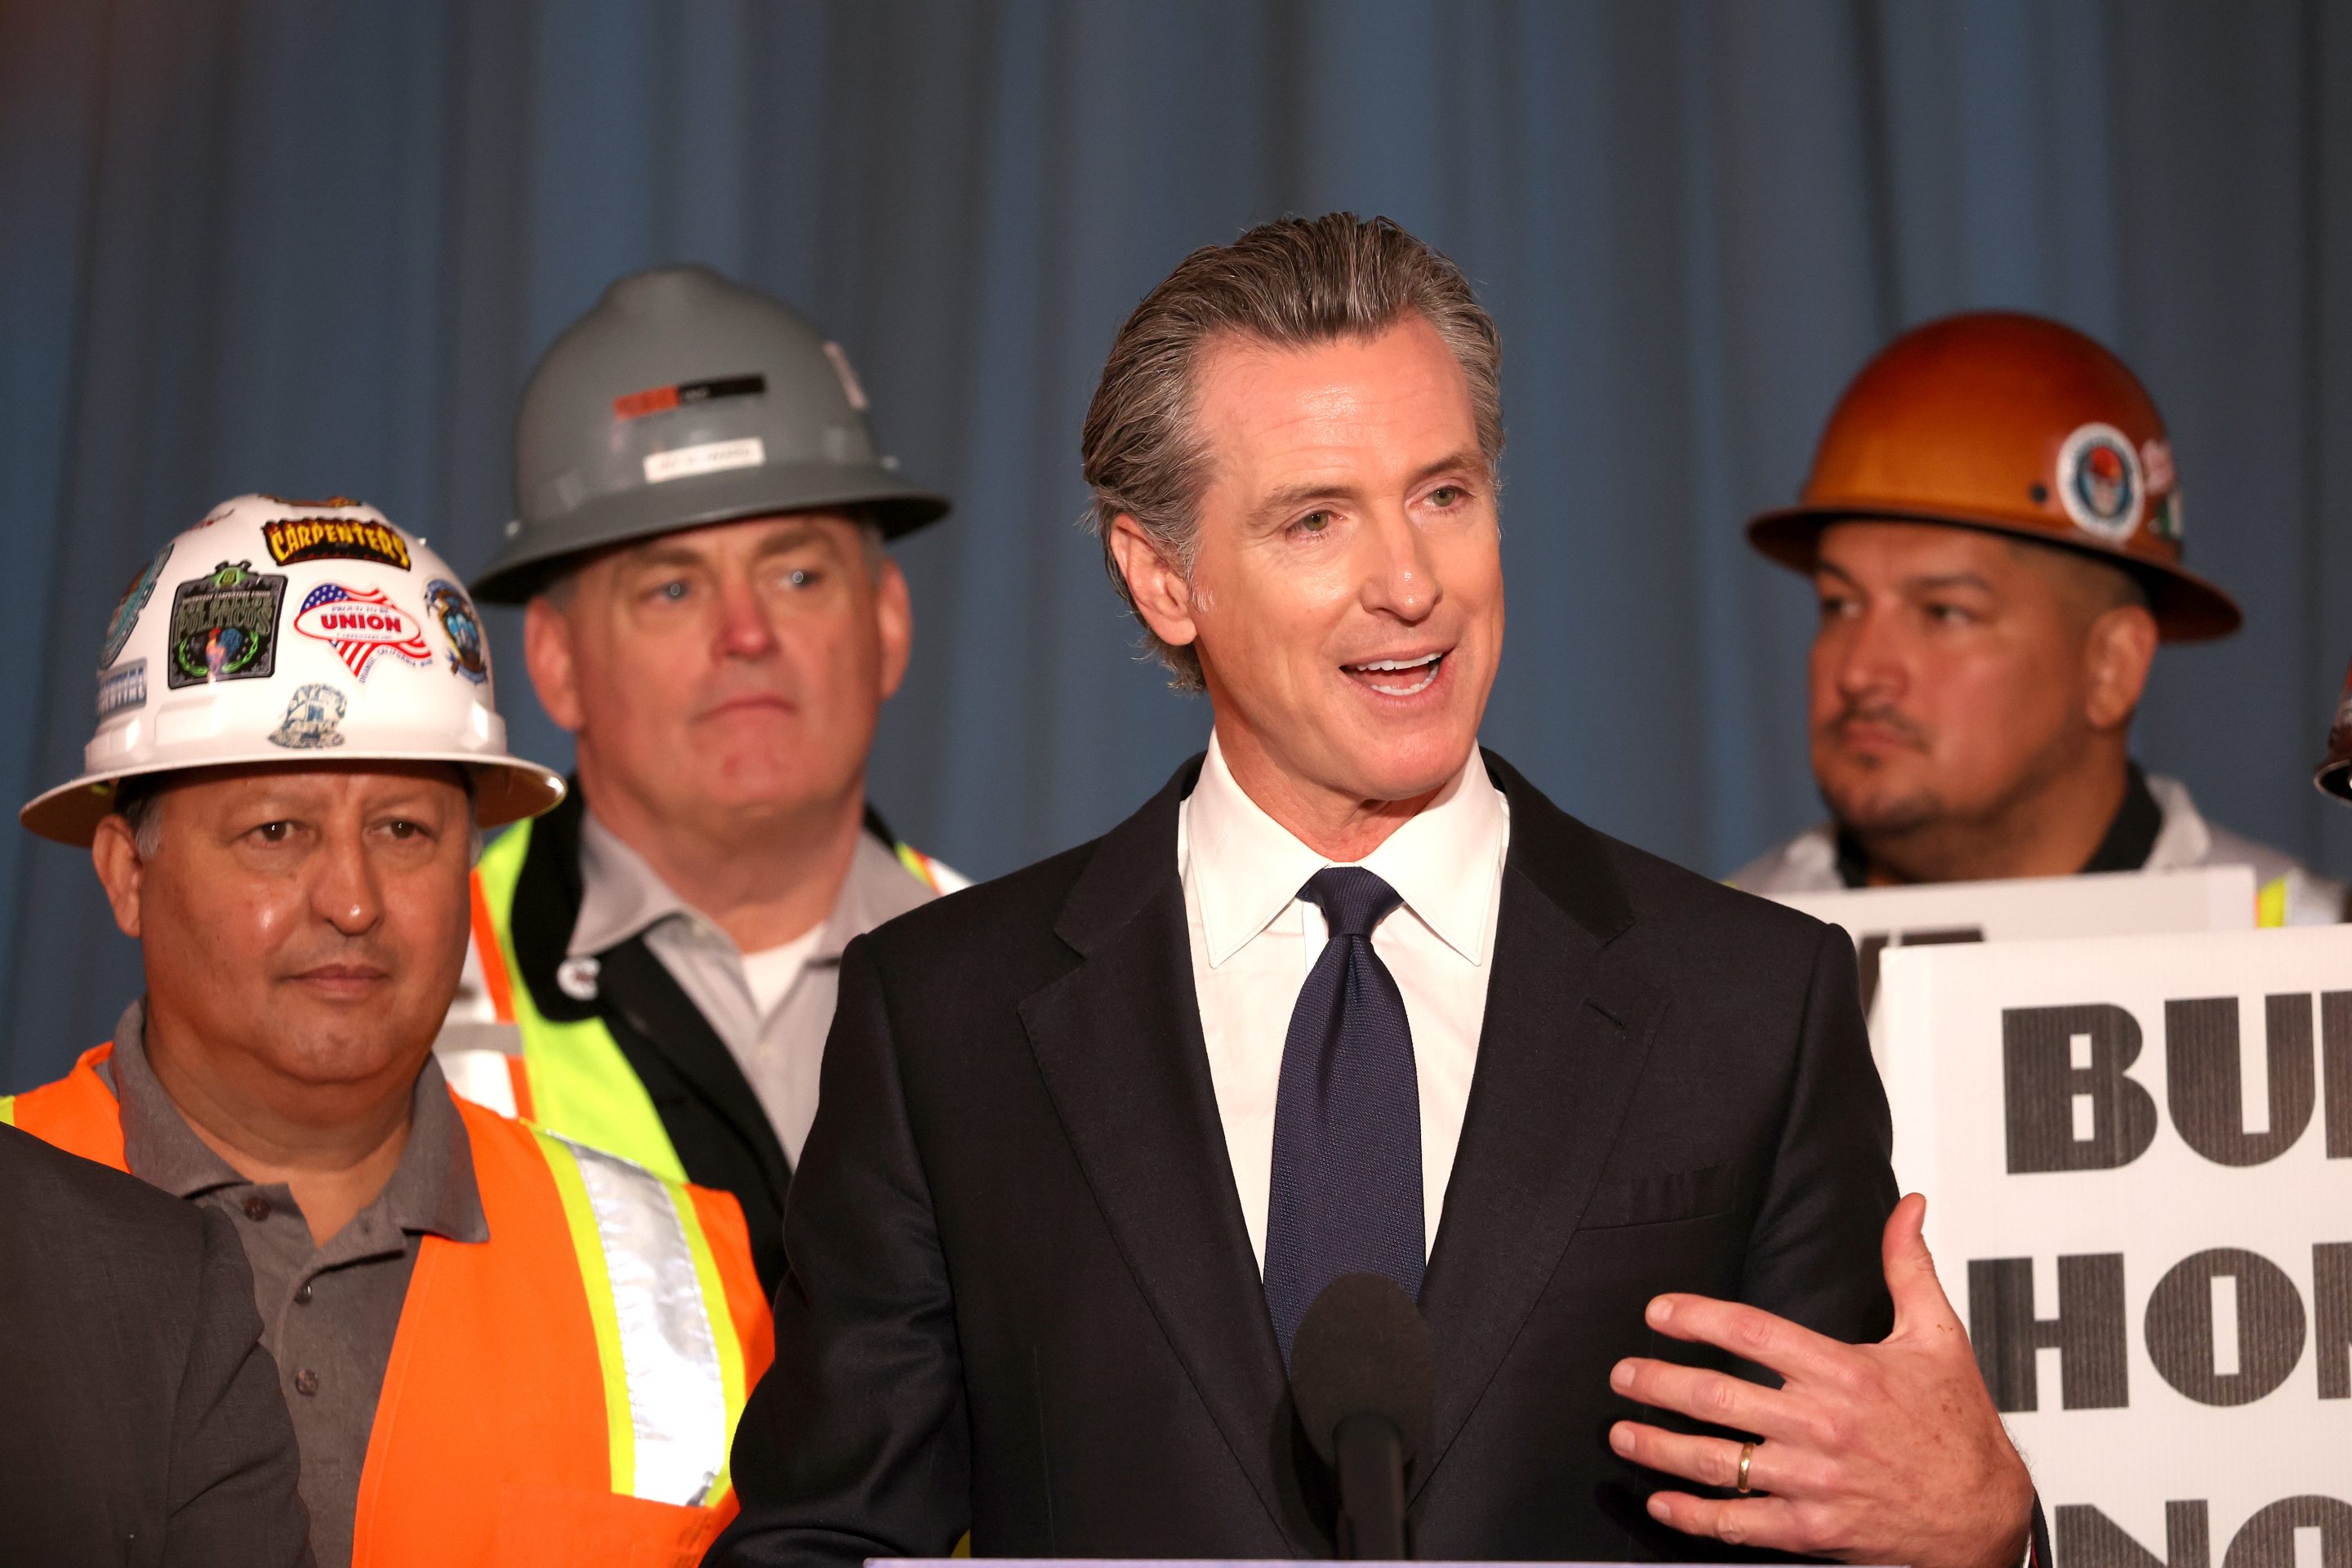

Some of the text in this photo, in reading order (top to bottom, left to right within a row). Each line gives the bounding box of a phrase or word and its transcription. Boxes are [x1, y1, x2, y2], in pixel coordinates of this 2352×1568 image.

[270, 521, 408, 568] CARPENTERS
[321, 614, 401, 633] UNION
[1966, 1241, 2352, 1414] HO
